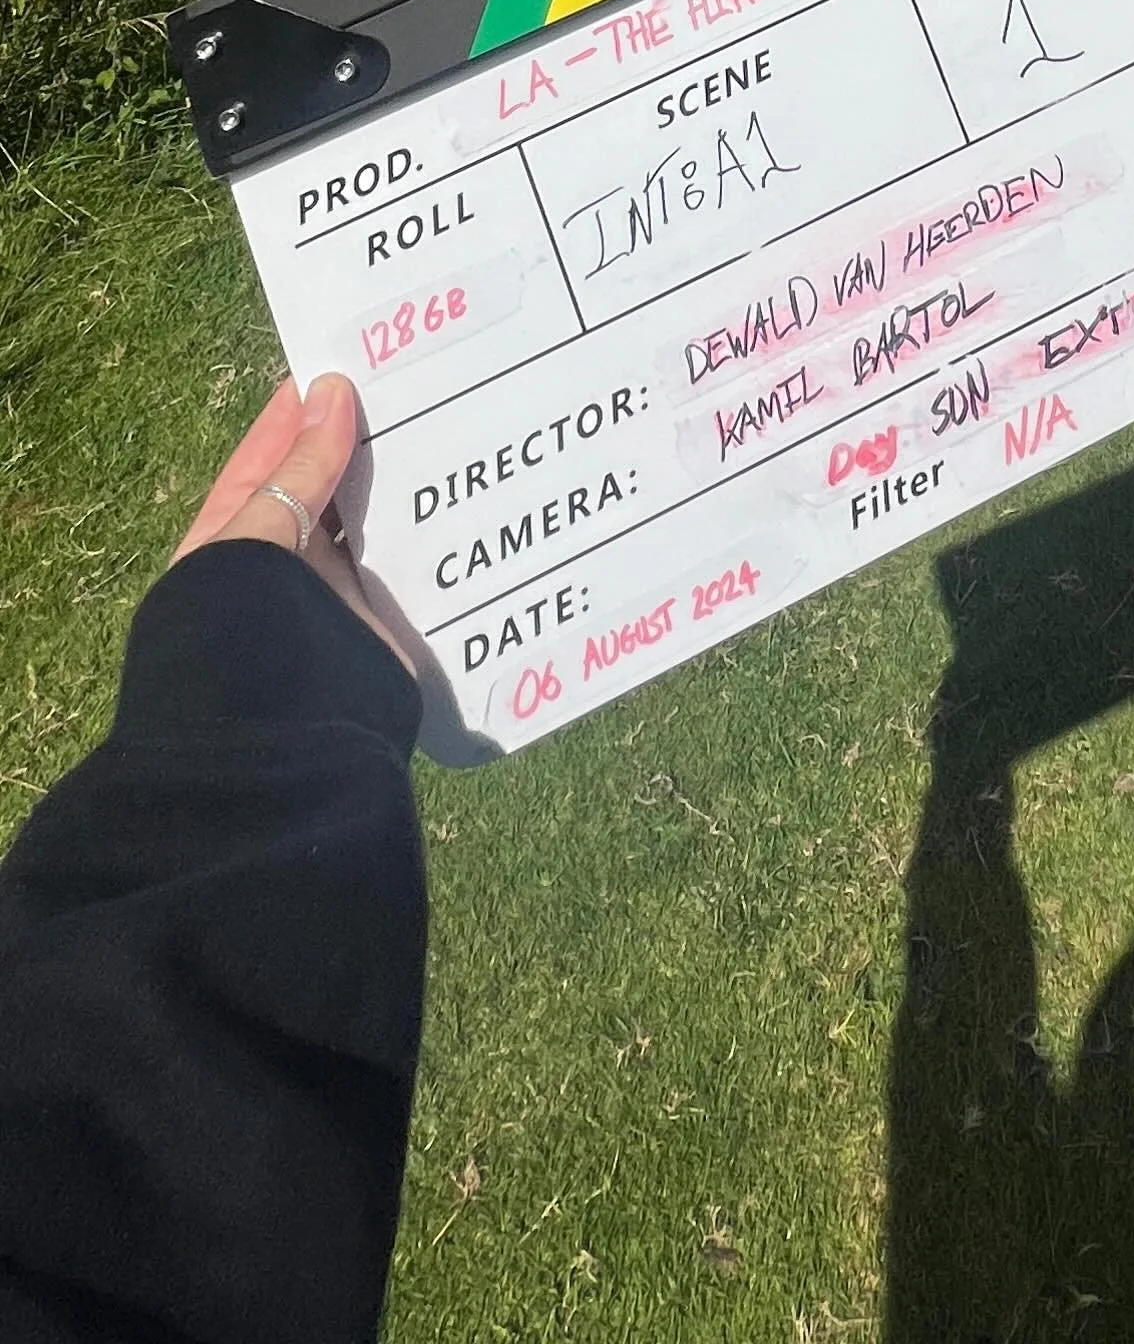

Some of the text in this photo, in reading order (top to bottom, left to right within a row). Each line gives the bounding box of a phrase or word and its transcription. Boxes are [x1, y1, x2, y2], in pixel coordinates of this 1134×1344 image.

[499, 60, 558, 119] LA
[657, 49, 773, 128] SCENE
[298, 148, 423, 225] PROD.
[368, 192, 475, 266] ROLL
[684, 154, 1064, 384] DEWALD VAN HEERDEN
[715, 282, 995, 461] KAMIL BARTOL
[931, 357, 991, 436] SUN
[414, 386, 649, 525] DIRECTOR:
[1005, 393, 1077, 466] N/A
[436, 469, 638, 589] CAMERA:
[851, 460, 945, 530] Filter
[465, 586, 590, 672] DATE:
[513, 560, 760, 719] 06 AUGUST 2024
